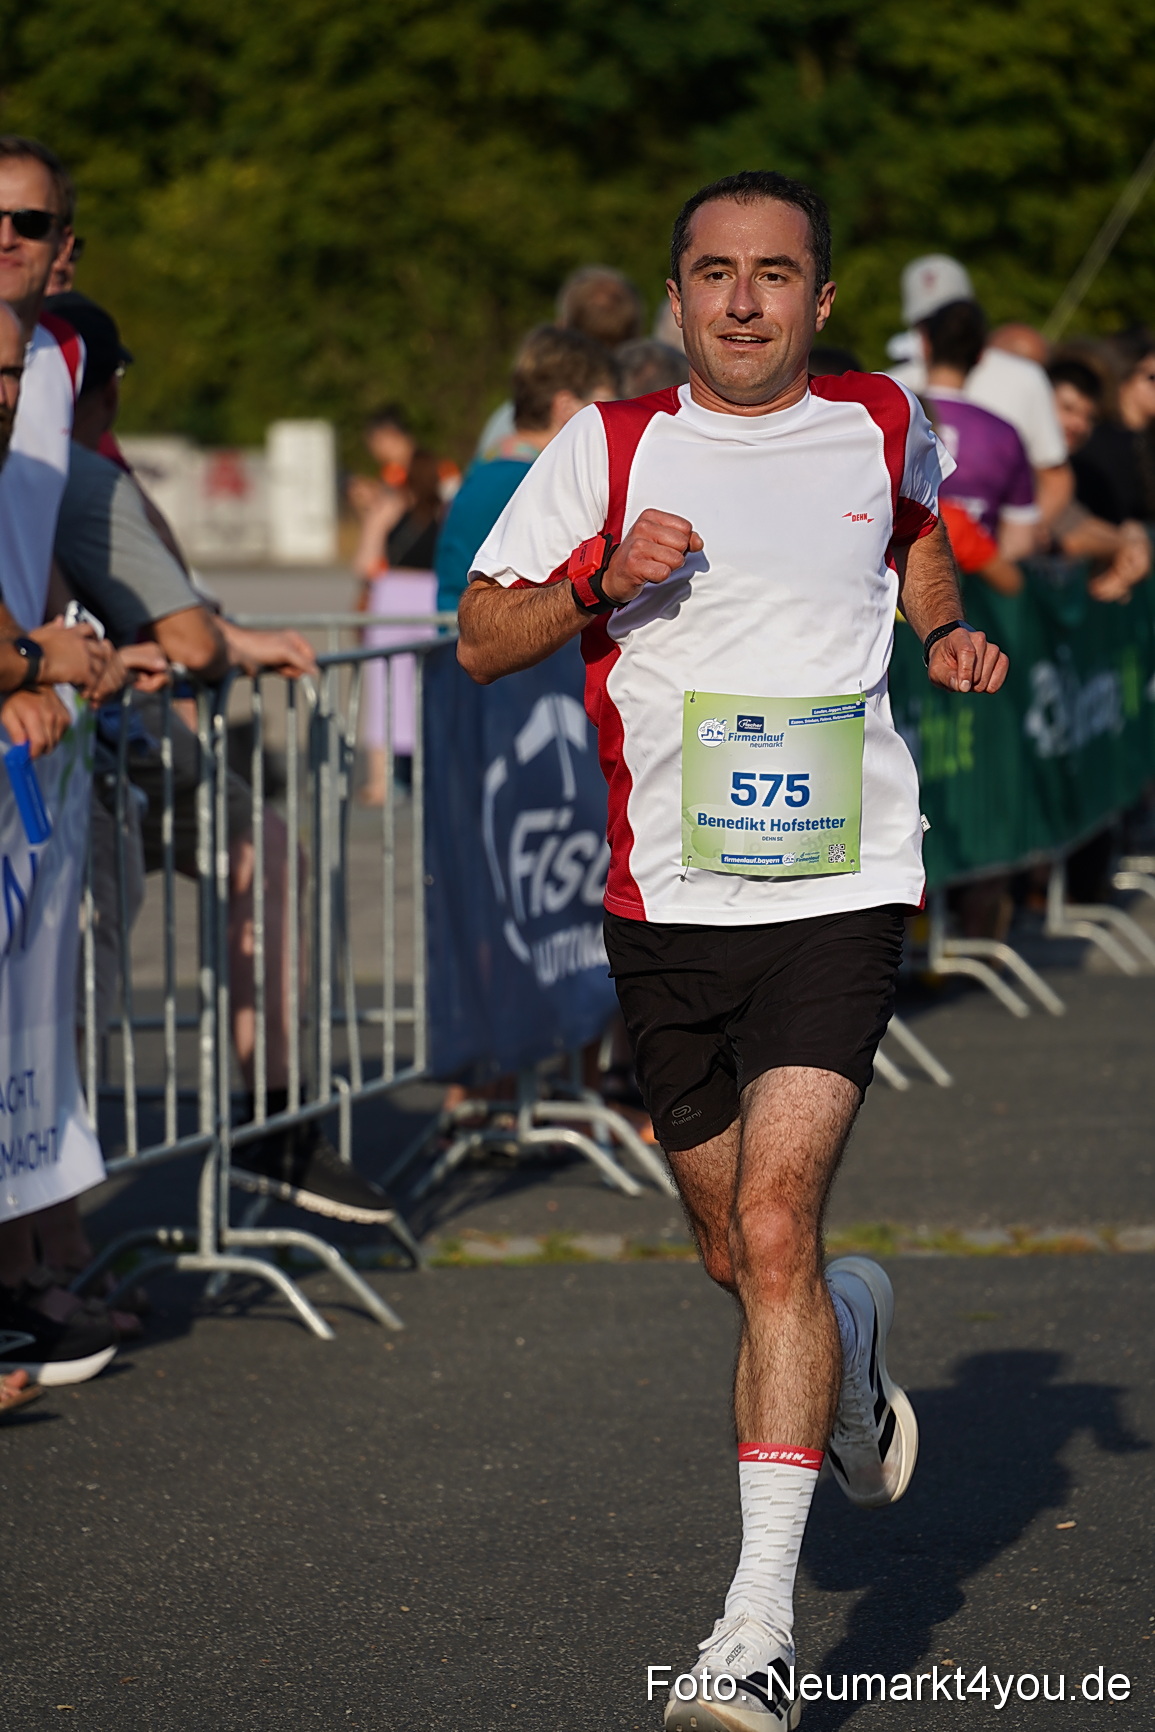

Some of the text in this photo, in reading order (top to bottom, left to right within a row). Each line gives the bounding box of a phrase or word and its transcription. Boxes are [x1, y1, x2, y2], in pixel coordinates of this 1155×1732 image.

[852, 513, 868, 522] DEHN
[728, 732, 785, 742] Firmenlauf
[730, 771, 811, 808] 575
[697, 812, 846, 832] Benedikt Hofstetter
[723, 855, 780, 865] firmenlauf.bayern
[671, 1110, 703, 1127] Kalenji
[758, 1451, 805, 1461] DEHN
